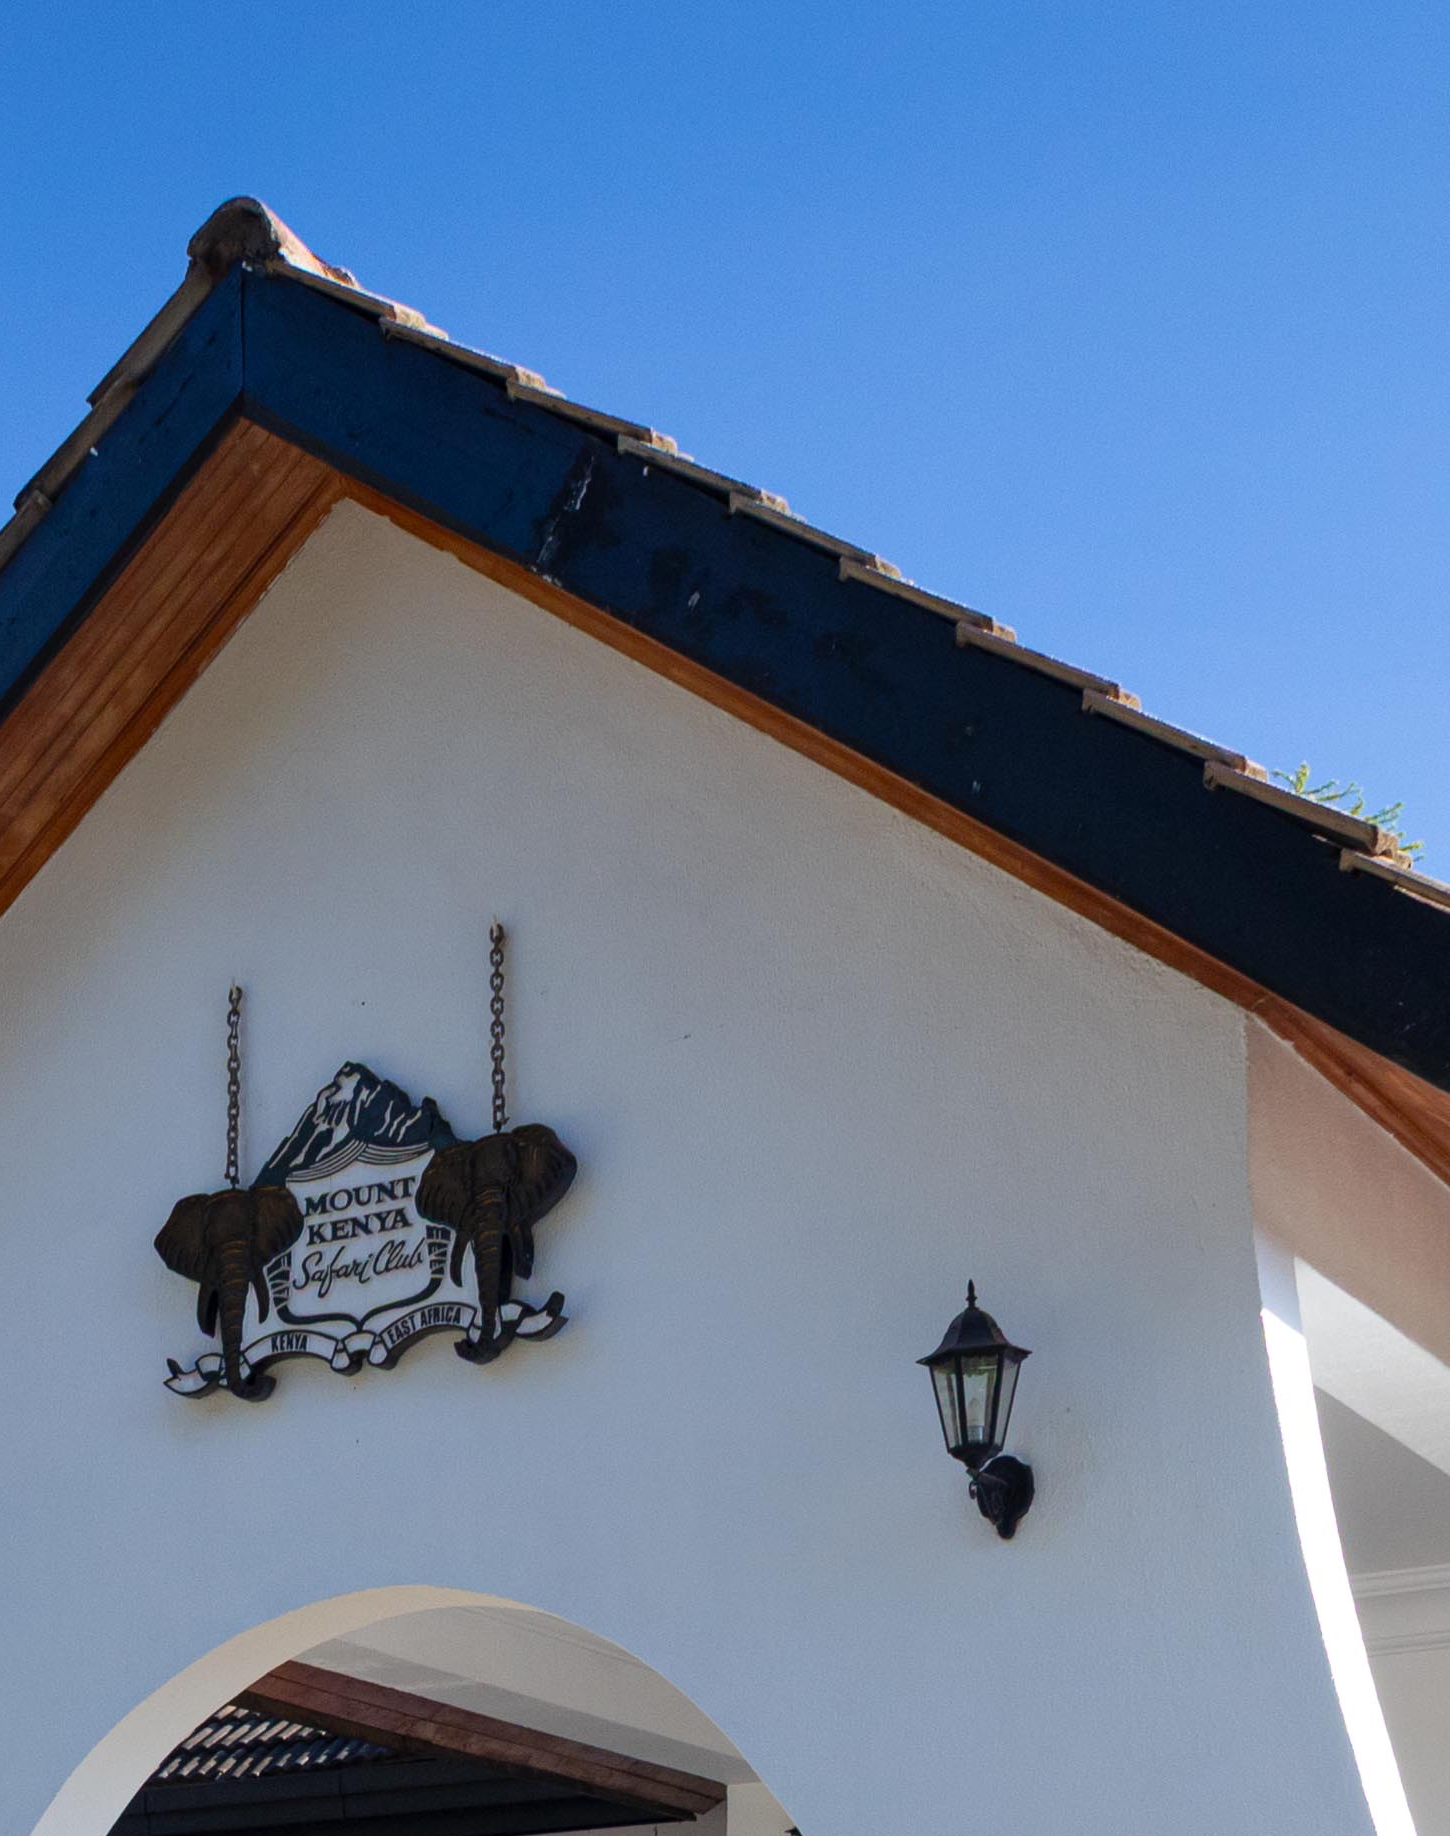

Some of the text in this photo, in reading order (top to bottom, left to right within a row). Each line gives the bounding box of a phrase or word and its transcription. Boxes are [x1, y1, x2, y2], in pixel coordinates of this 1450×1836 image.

[304, 1176, 416, 1217] MOUNT
[306, 1208, 412, 1246] KENYA
[293, 1237, 426, 1298] Safari Club
[271, 1335, 308, 1353] KENYA
[388, 1305, 462, 1346] EAST AFRICA
